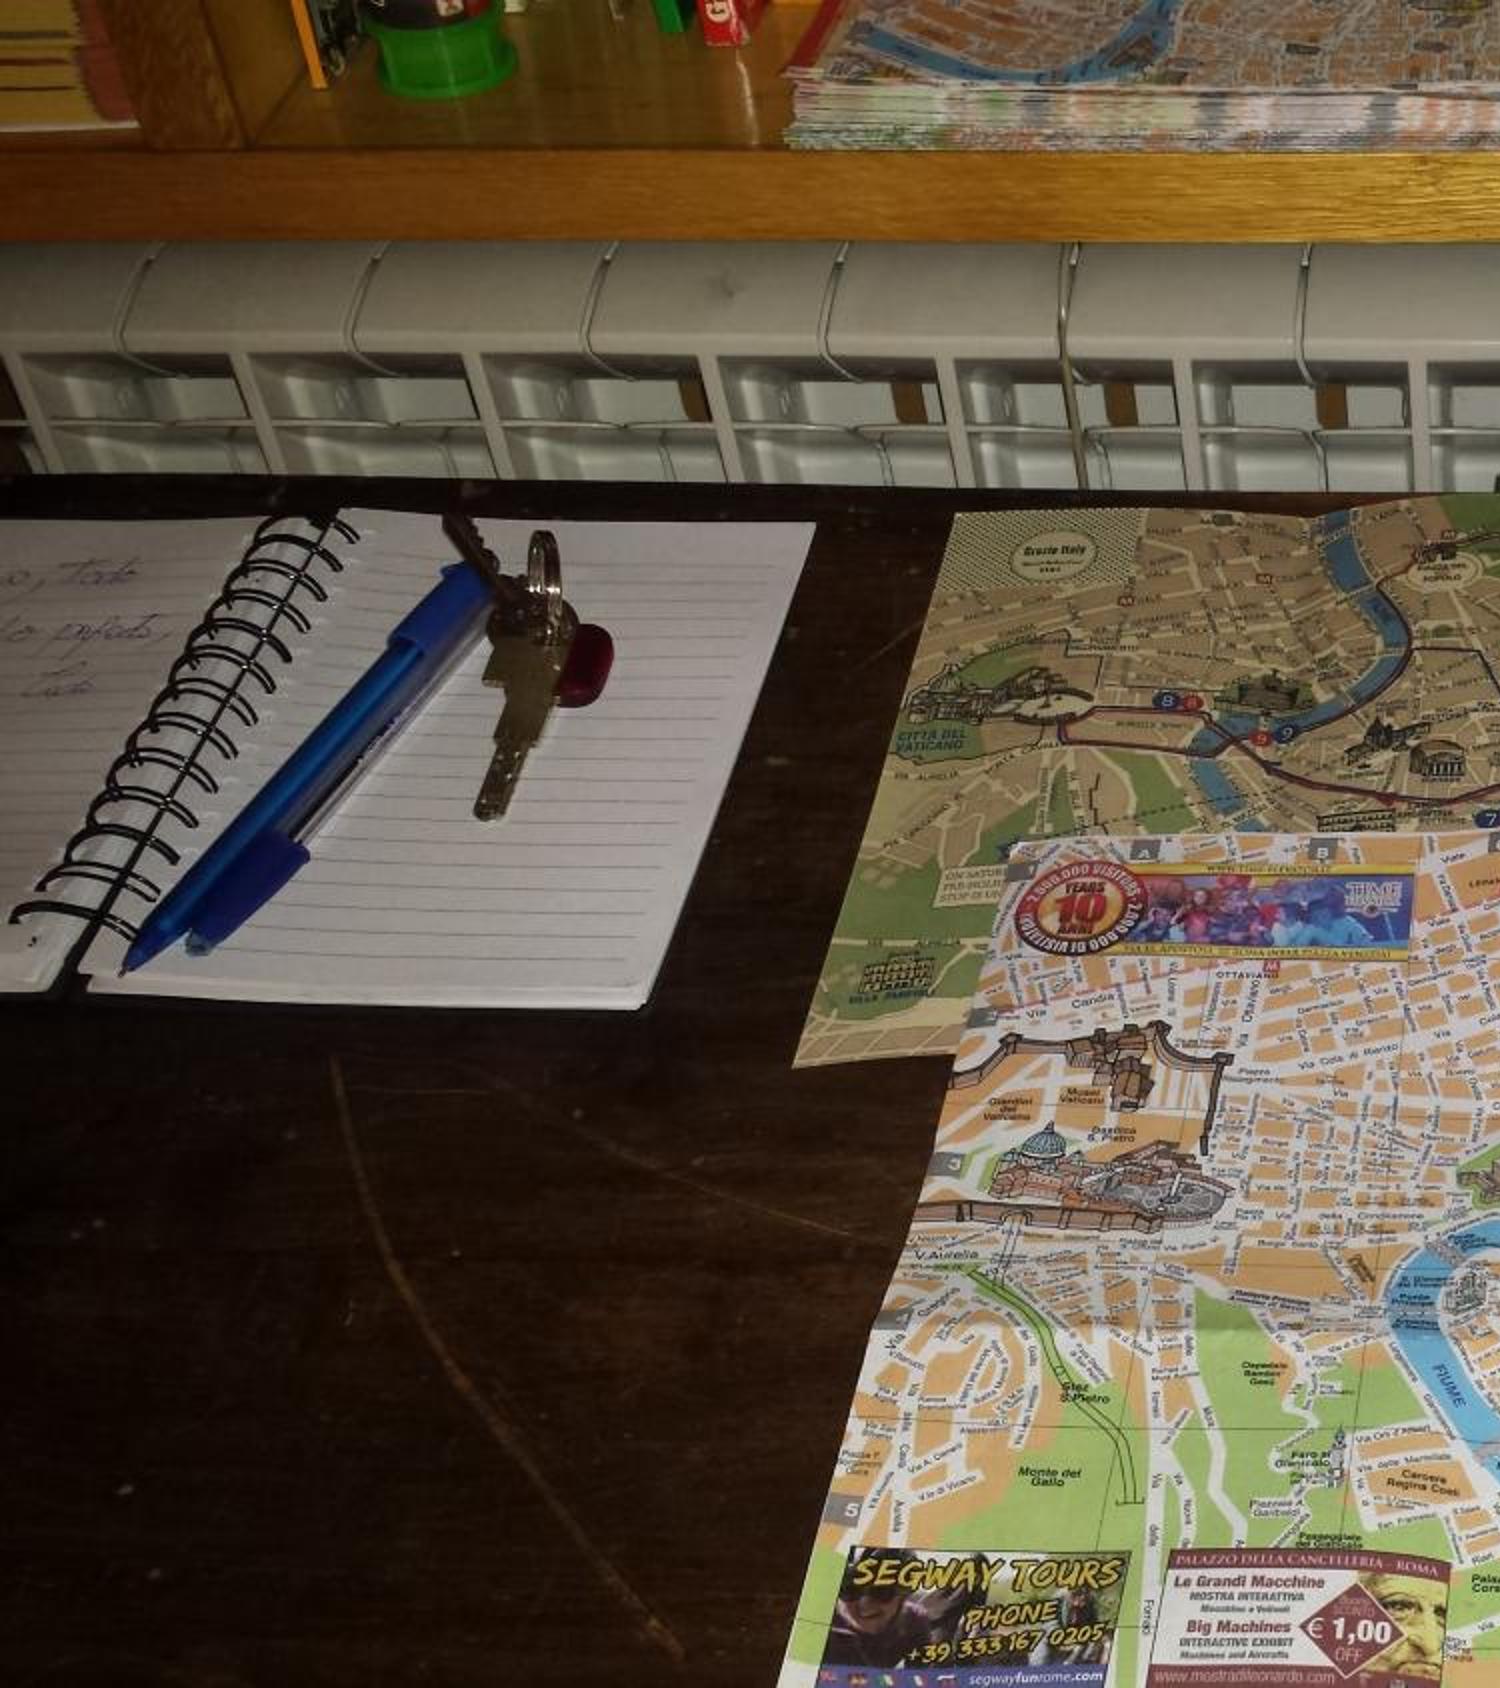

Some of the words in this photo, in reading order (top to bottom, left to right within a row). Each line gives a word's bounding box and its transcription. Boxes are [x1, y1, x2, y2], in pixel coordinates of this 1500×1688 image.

[1066, 882, 1106, 894] YEARS
[1055, 894, 1107, 924] 10
[1026, 1009, 1047, 1019] Via
[1071, 993, 1115, 1009] Candia
[1433, 1029, 1451, 1039] Via
[1298, 1061, 1315, 1070] Via
[1320, 1056, 1344, 1065] Cola
[1333, 1089, 1349, 1099] Via
[1099, 1133, 1135, 1143] Pietro
[1432, 1362, 1467, 1408] FIUME
[1355, 1433, 1372, 1444] Via
[1291, 1451, 1317, 1459] Faro
[1018, 1467, 1058, 1478] Monte
[1357, 1465, 1372, 1473] Via
[1030, 1477, 1065, 1487] Gallo
[1387, 1477, 1422, 1490] Regina
[1402, 1469, 1448, 1485] Carcere
[1176, 1550, 1242, 1566] PALAZZO
[1245, 1553, 1285, 1566] DELLA
[1289, 1554, 1383, 1569] CANCELLERIA
[1396, 1560, 1439, 1576] ROMA
[853, 1557, 1004, 1592] SEGWAY
[1011, 1558, 1124, 1591] TOURS
[1173, 1575, 1195, 1588] Le
[1197, 1575, 1247, 1588] Grandi
[1250, 1575, 1325, 1589] Macchine
[1189, 1591, 1234, 1601] MOSTRA
[1238, 1591, 1305, 1601] INTERATTIVA
[963, 1600, 1059, 1633] PHONE
[1186, 1619, 1212, 1634] Big
[1216, 1620, 1291, 1634] Machines
[1307, 1618, 1325, 1638] €
[1331, 1617, 1393, 1645] 1,00
[1478, 1621, 1494, 1631] Via
[953, 1637, 1002, 1658] 333
[1008, 1630, 1042, 1652] 167
[1050, 1624, 1104, 1646] 0205
[1179, 1637, 1249, 1647] INTERACTIVE
[1252, 1637, 1294, 1647] EXHIBIT
[1333, 1647, 1364, 1663] OFF
[969, 1671, 1104, 1687] segwayfunrome.com
[1153, 1670, 1335, 1687] www.mostradileonardo.com
